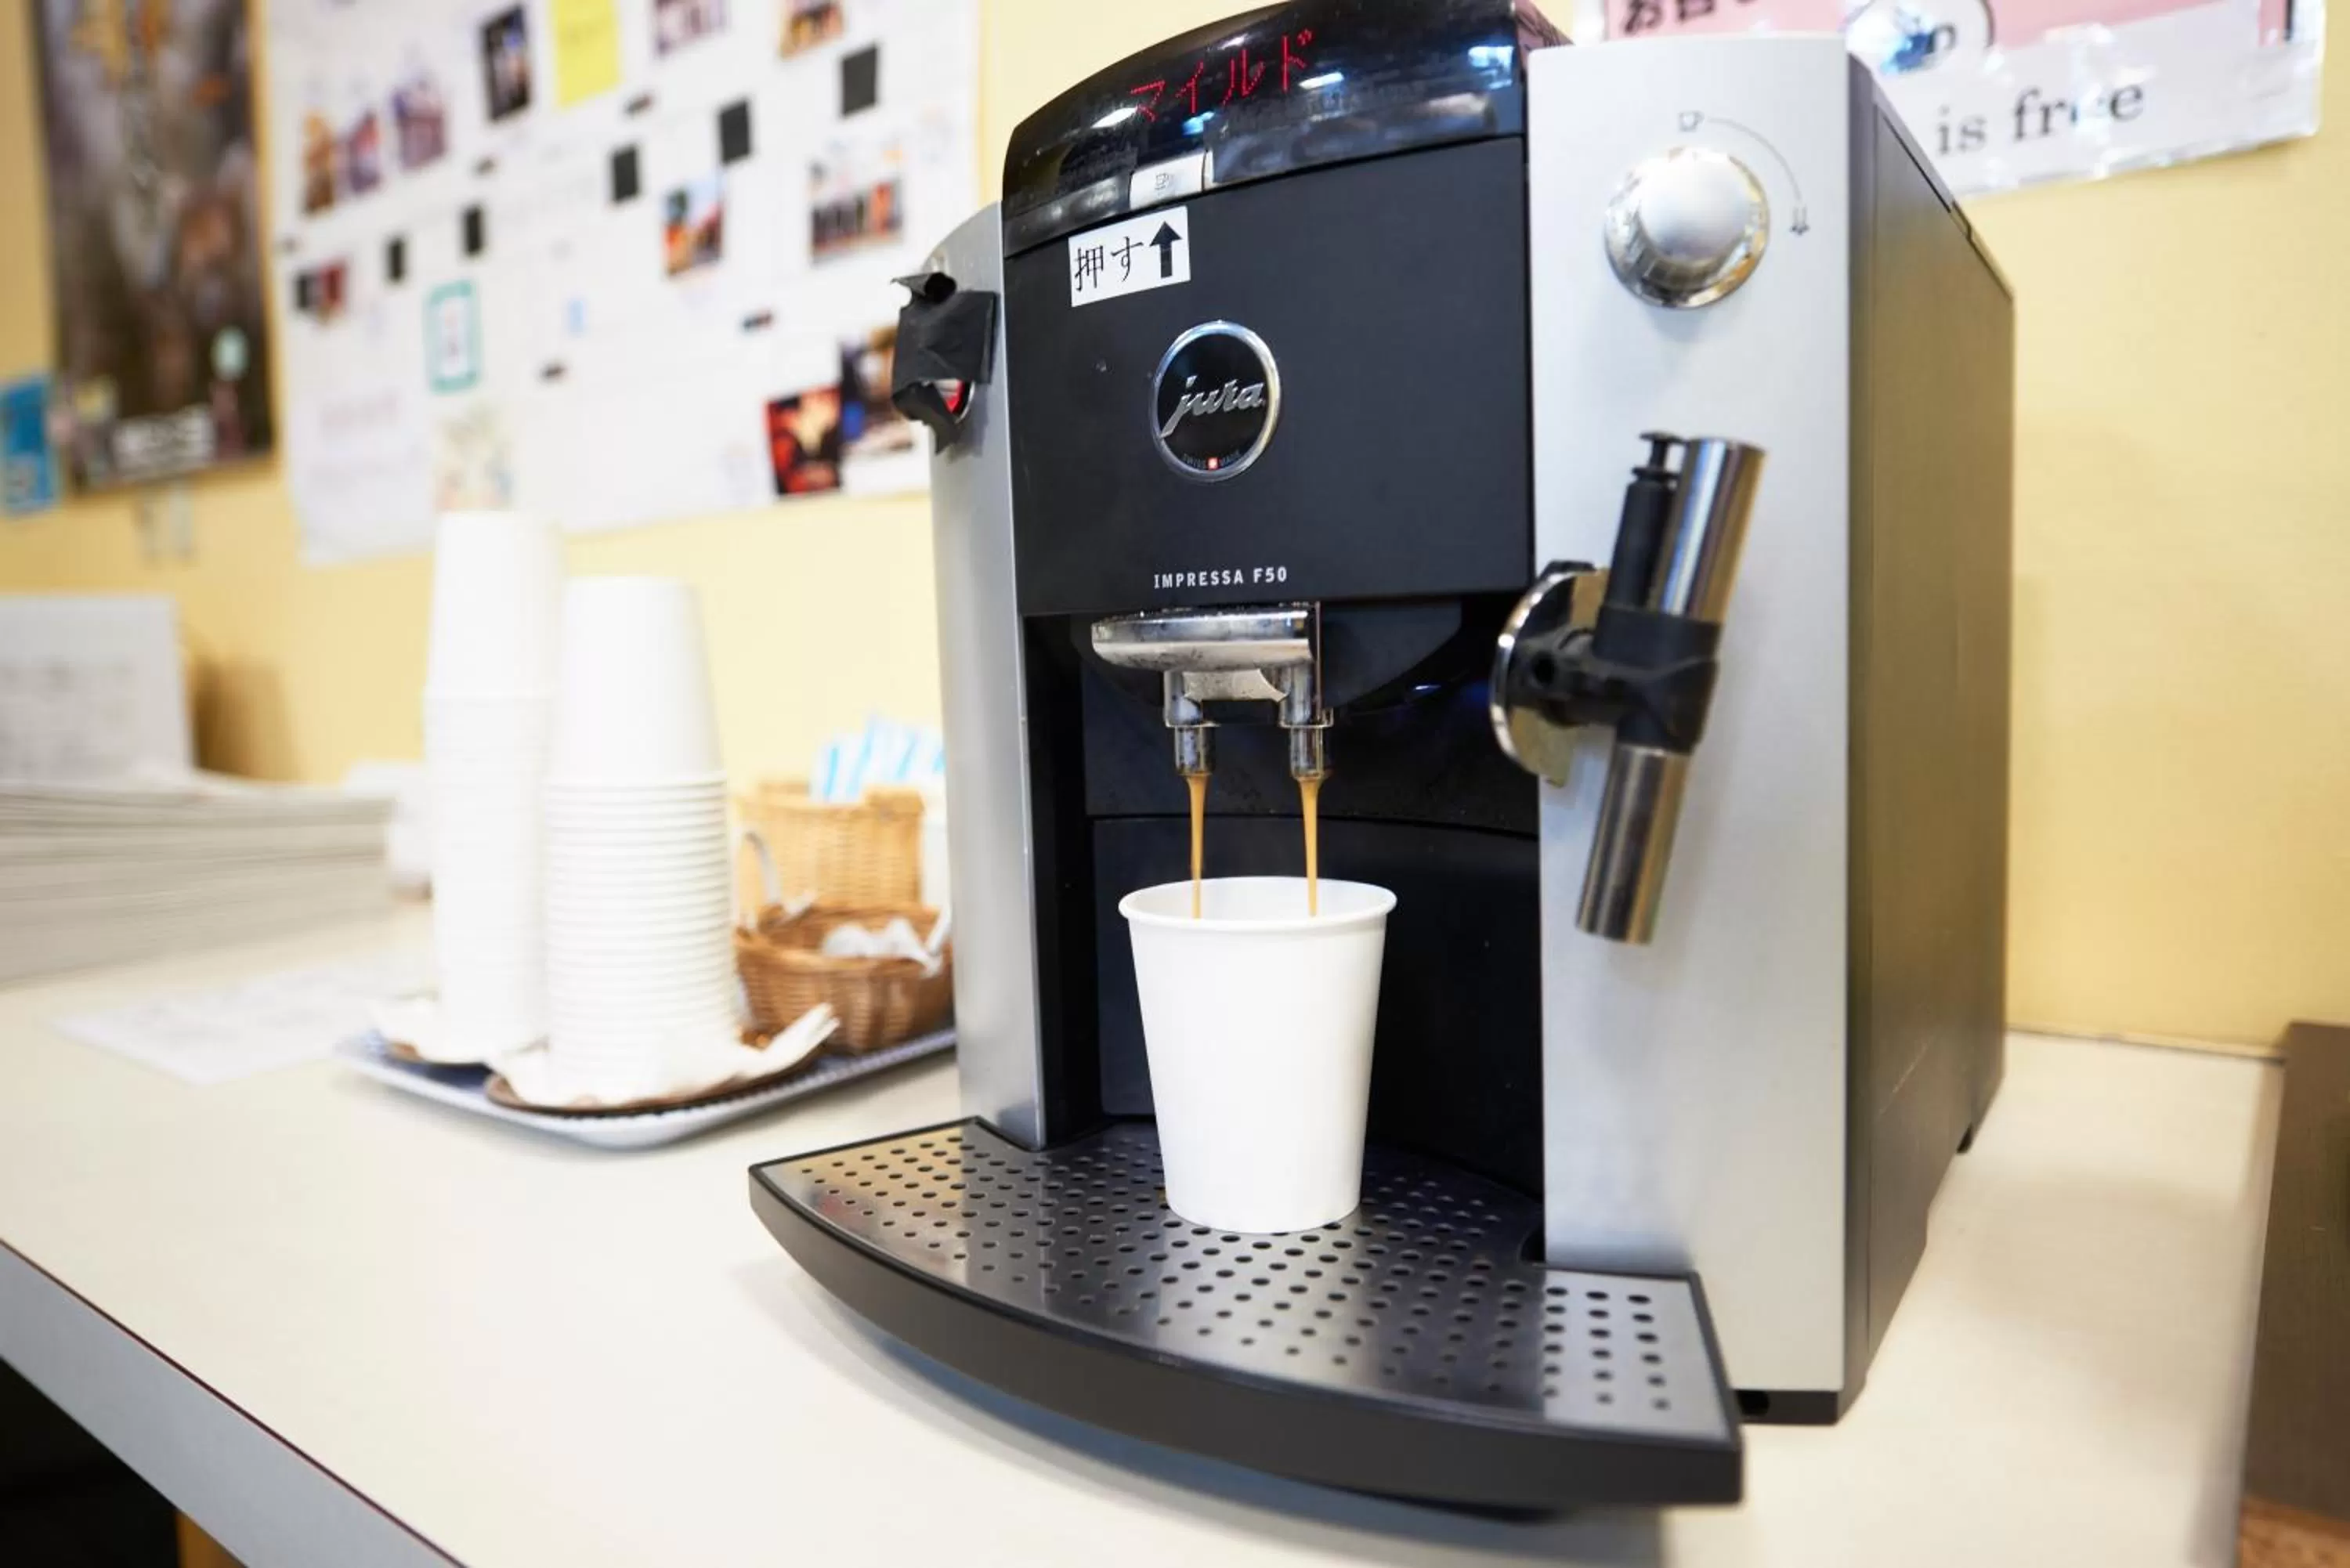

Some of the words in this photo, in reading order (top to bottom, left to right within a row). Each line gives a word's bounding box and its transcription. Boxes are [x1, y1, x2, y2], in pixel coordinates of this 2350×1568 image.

[1130, 28, 1314, 123] マイルド
[1937, 103, 1988, 154] is
[1075, 236, 1144, 292] 押す
[1159, 374, 1264, 439] jura
[1154, 569, 1244, 589] IMPRESSA
[1253, 566, 1287, 583] F50
